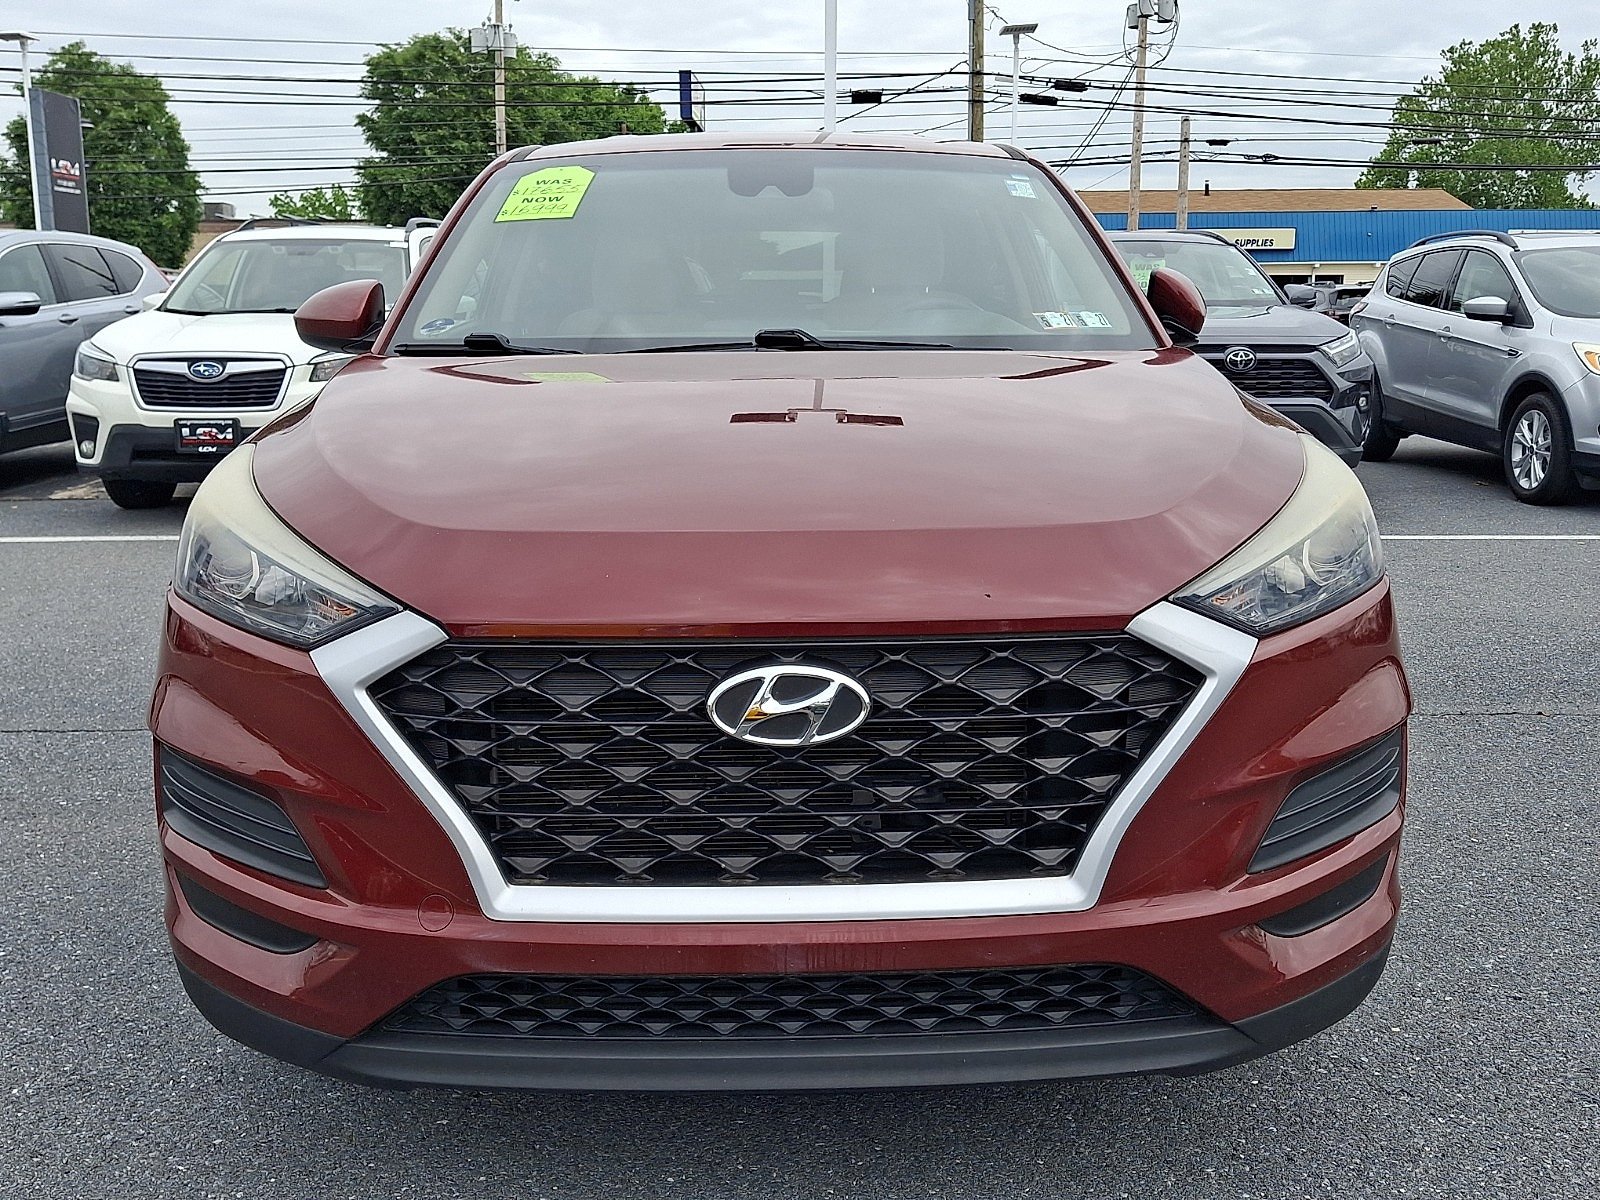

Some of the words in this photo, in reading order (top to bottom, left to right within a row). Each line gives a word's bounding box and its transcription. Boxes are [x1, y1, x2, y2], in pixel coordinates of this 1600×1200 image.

[536, 178, 573, 186] WAS
[521, 195, 565, 204] NOW
[1234, 238, 1275, 247] SUPPLIES
